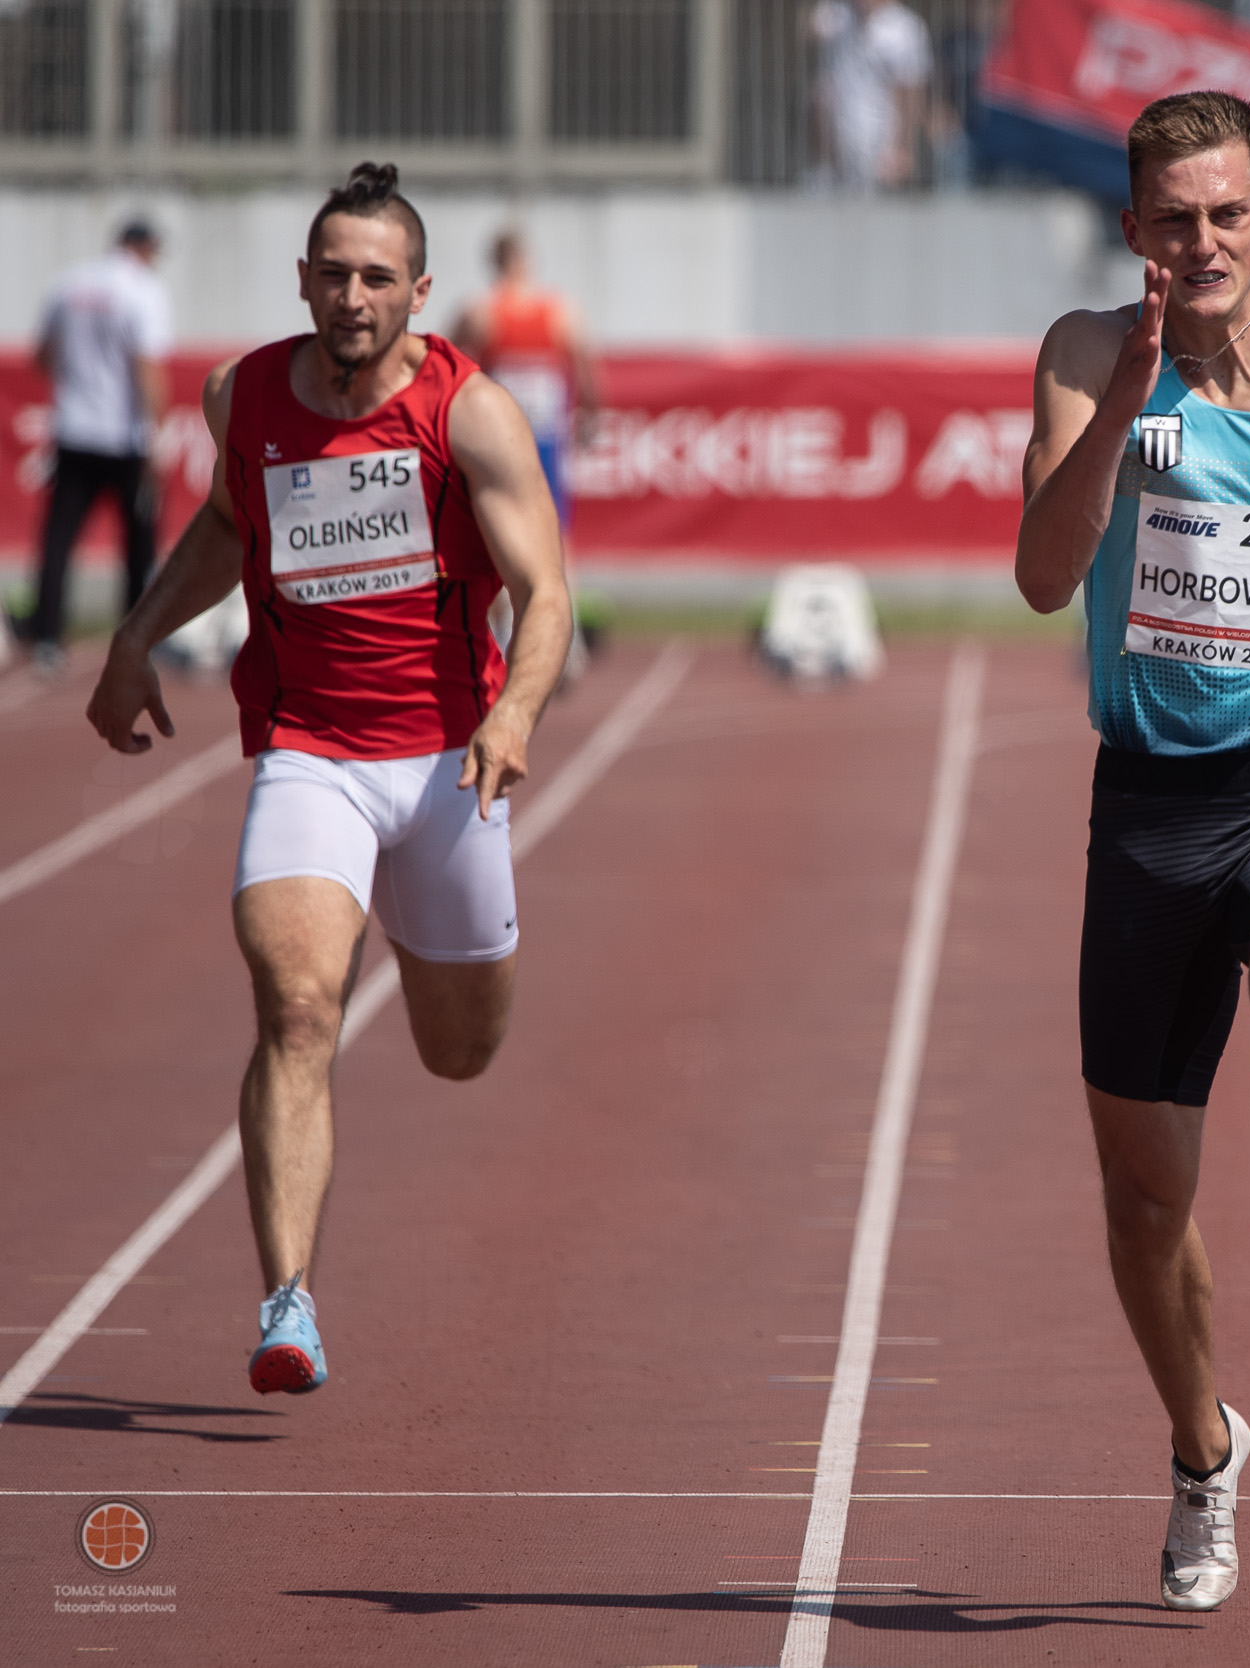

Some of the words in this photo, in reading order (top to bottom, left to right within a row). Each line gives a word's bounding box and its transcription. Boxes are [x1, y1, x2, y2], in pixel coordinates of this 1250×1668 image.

[562, 405, 908, 498] EKKIEJ
[349, 457, 411, 492] 545
[288, 510, 410, 551] OLBIŃSKI
[294, 576, 367, 601] KRAKÓW
[373, 569, 411, 589] 2019
[1153, 636, 1236, 662] KRAKÓW
